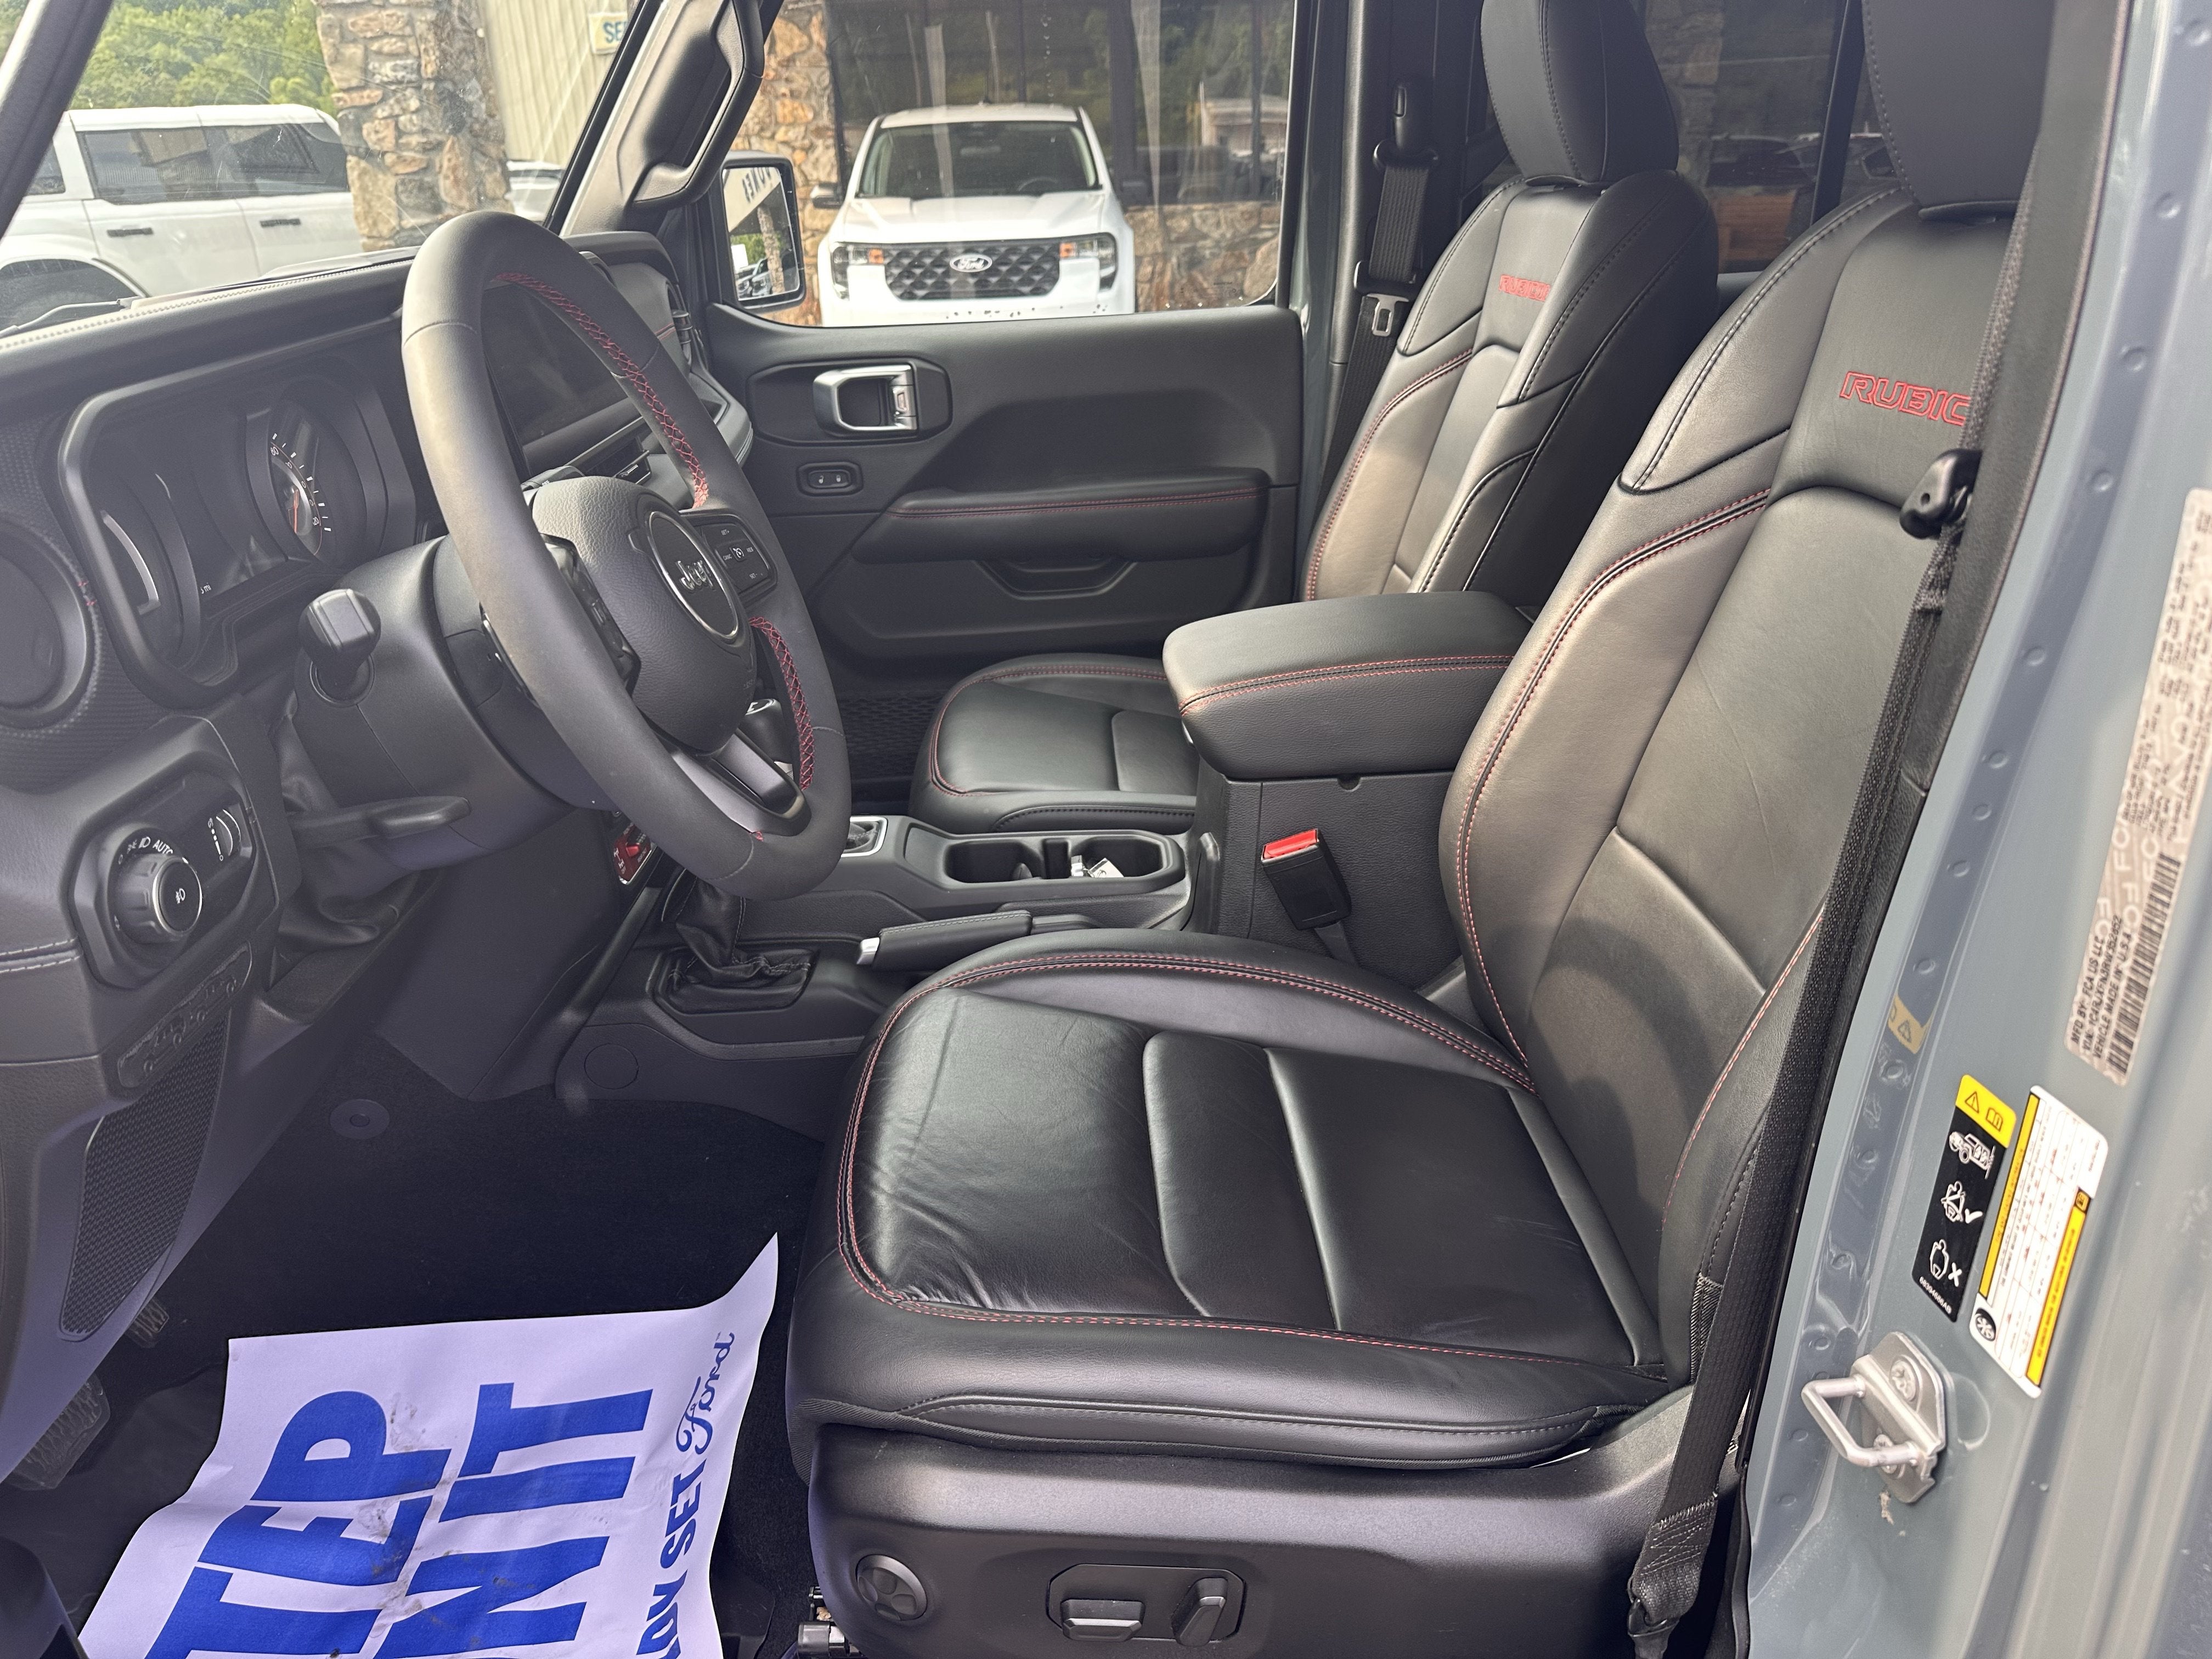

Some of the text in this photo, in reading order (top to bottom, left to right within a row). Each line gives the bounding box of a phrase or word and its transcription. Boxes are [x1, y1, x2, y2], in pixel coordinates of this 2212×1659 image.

[603, 21, 627, 43] SE
[676, 560, 713, 590] Jeep
[2091, 934, 2104, 956] LLC
[2087, 957, 2099, 974] US
[2081, 974, 2095, 998] FCA
[2092, 1015, 2111, 1059] VEHICLE
[2103, 980, 2119, 1014] MADE
[676, 1332, 735, 1455] Ford
[660, 1458, 707, 1569] SET
[371, 1536, 610, 1659] N
